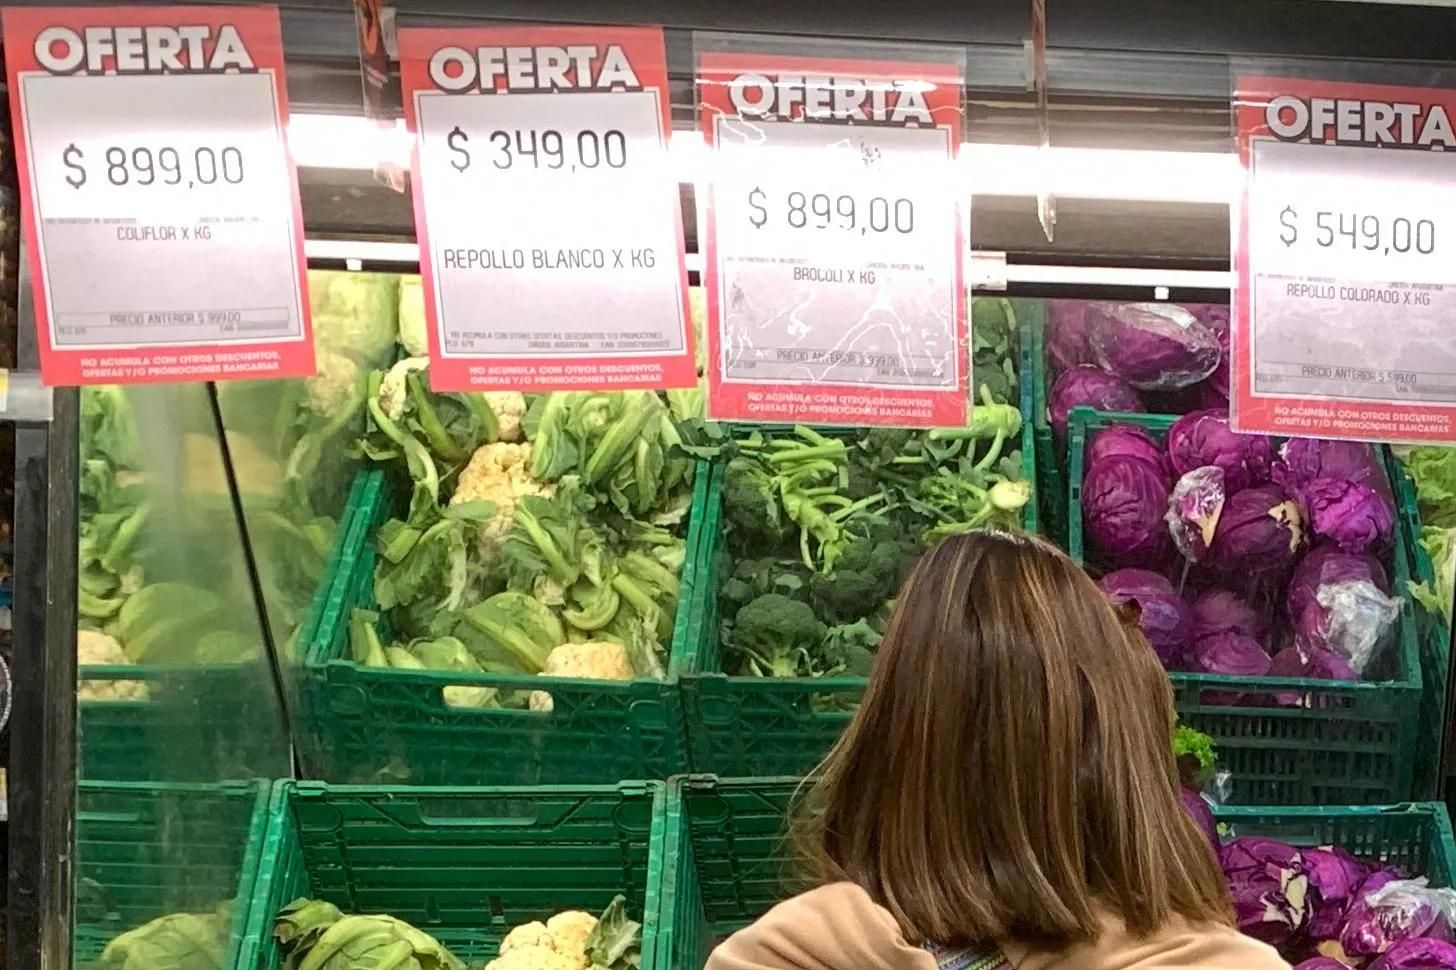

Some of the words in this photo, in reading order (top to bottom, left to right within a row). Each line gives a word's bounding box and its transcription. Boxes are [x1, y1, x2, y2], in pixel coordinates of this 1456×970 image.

[34, 25, 256, 73] OFERTA
[430, 45, 641, 91] OFERTA
[729, 73, 934, 124] OFERTA
[62, 143, 87, 189] $
[105, 146, 244, 188] 899,00
[447, 126, 471, 173] $
[489, 129, 627, 173] 349,00
[117, 226, 176, 241] COLIFLOR
[182, 227, 190, 240] X
[194, 226, 212, 240] KG
[748, 186, 768, 229] $
[787, 191, 914, 236] 899,00
[1280, 205, 1298, 247] $
[1316, 211, 1435, 256] 549,00
[444, 249, 524, 269] REPOLLO
[532, 249, 605, 269] BLANCO
[613, 249, 624, 268] X
[632, 249, 656, 268] KG
[848, 269, 855, 283] X
[859, 270, 876, 285] KG
[1287, 283, 1336, 299] REPOLLO
[1340, 287, 1399, 304] COLORADO
[1403, 291, 1411, 305] X
[1415, 292, 1431, 306] KG
[110, 314, 143, 325] PRECIO
[148, 312, 194, 325] ANTERIOR
[1302, 366, 1331, 378] PRECIO
